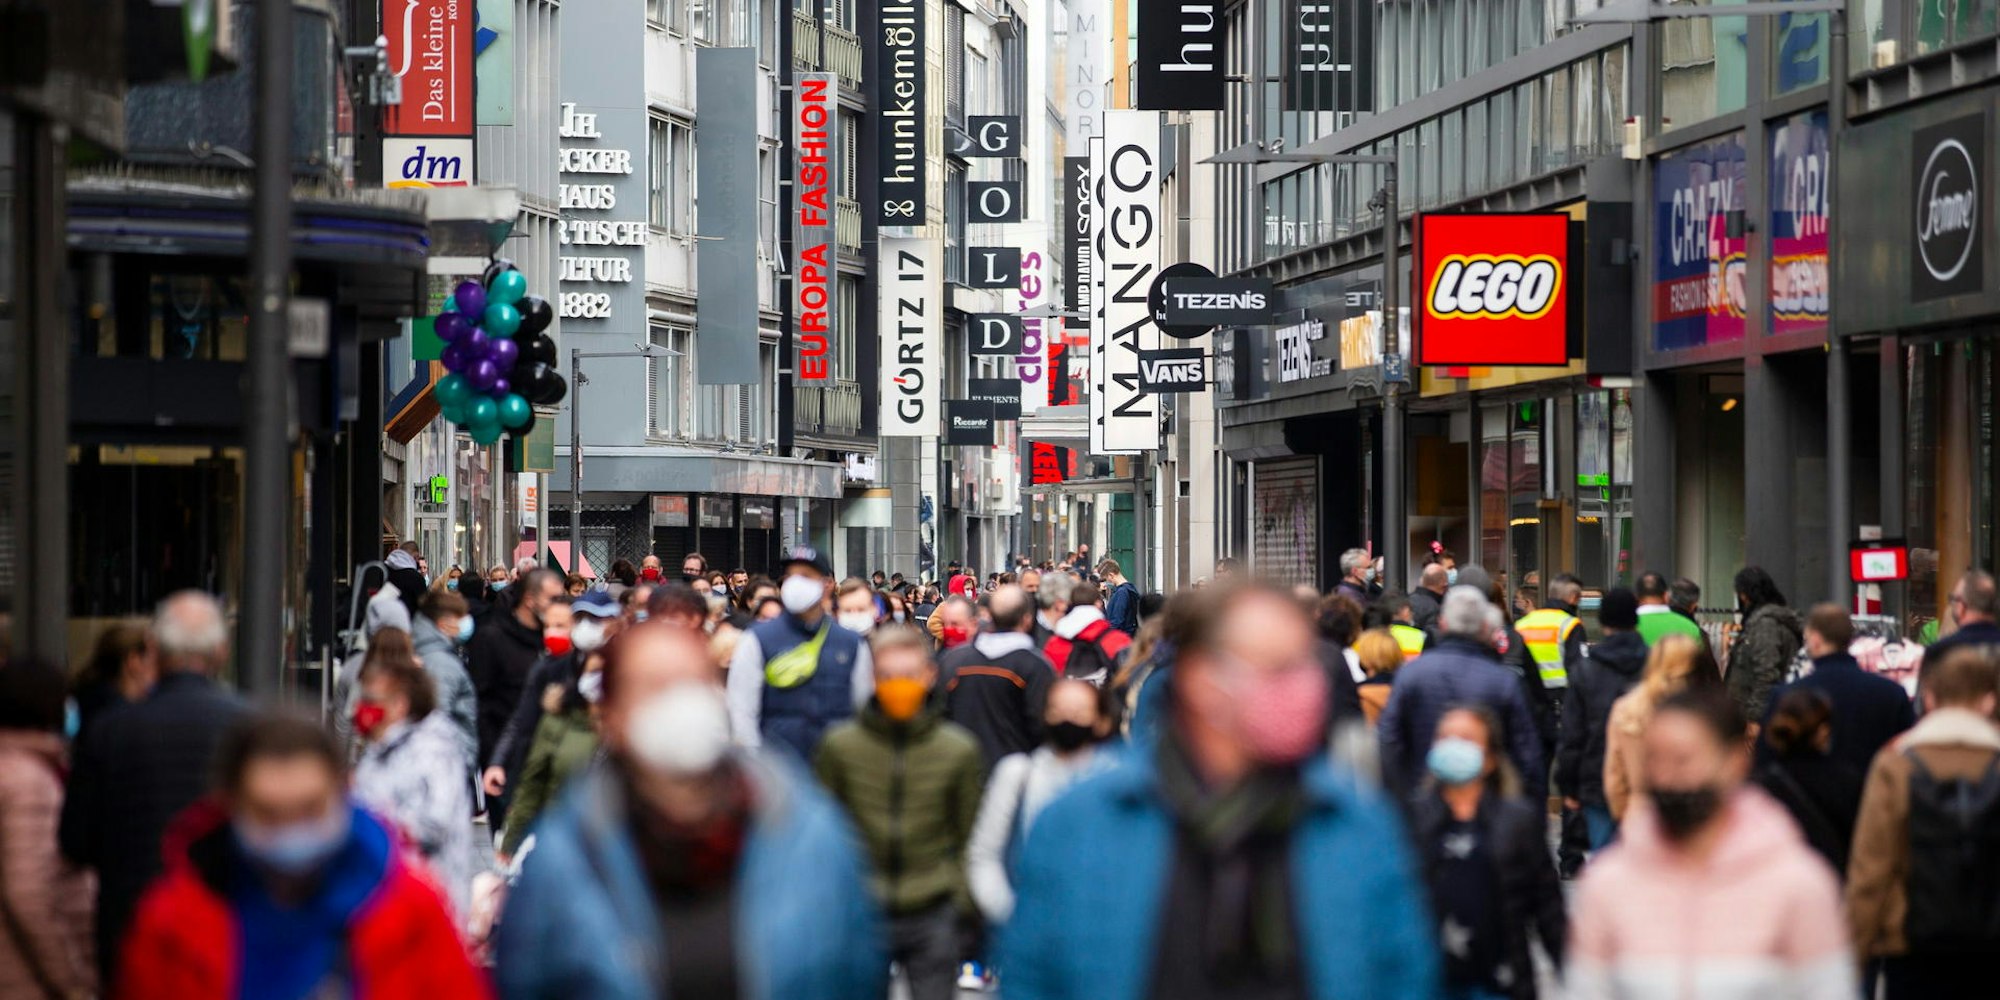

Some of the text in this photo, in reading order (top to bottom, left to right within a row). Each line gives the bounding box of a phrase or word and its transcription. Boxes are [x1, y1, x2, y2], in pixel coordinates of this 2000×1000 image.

[423, 6, 444, 122] Das kleine
[402, 146, 461, 180] dm
[800, 80, 828, 380] EUROPA FASHION
[1671, 177, 1732, 267] CRAZY
[899, 250, 924, 281] 17
[1110, 144, 1152, 418] MANGO
[1432, 258, 1557, 314] LEGO
[1140, 358, 1203, 384] VANS
